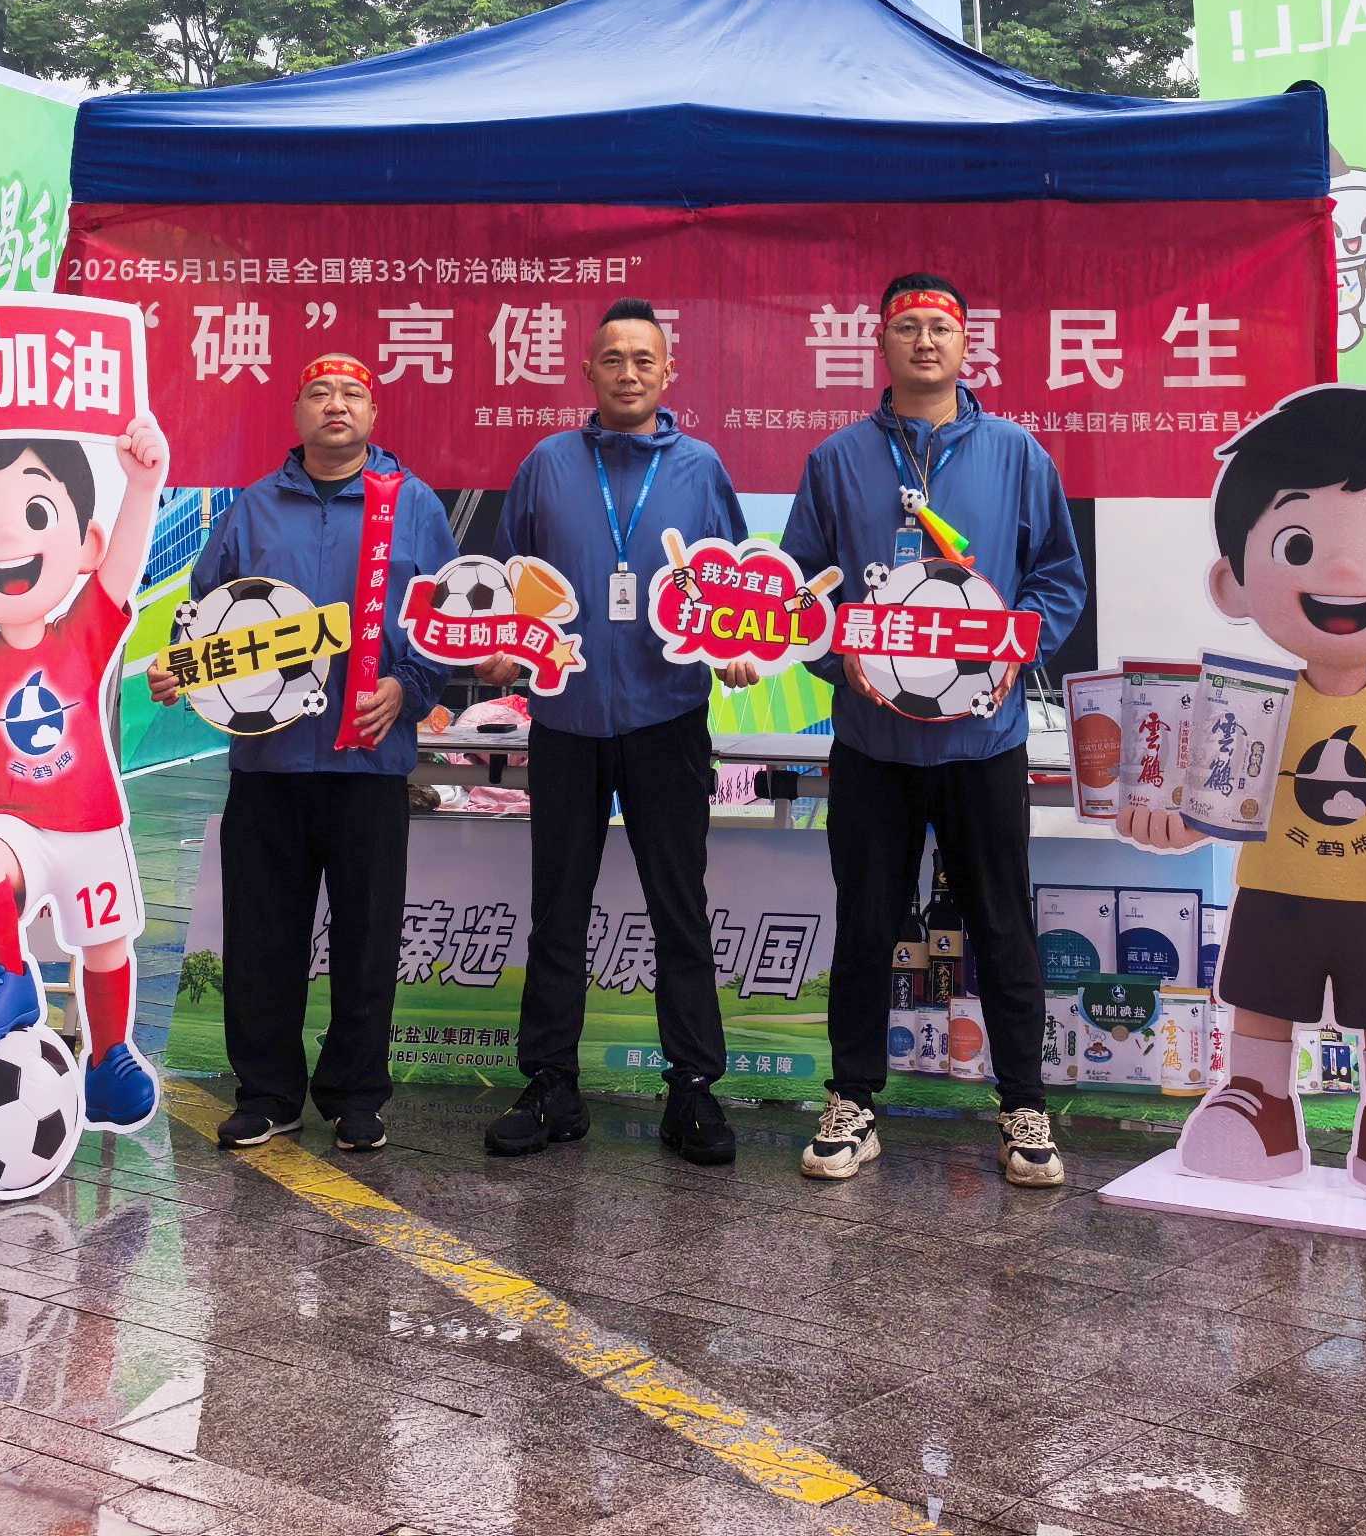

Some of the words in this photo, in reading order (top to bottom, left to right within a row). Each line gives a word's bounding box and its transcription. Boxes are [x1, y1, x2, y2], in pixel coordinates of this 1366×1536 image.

[139, 302, 681, 386] “碘”亮健
[984, 410, 1262, 433] 北盐业集团有限公司宜昌
[362, 542, 389, 640] 宜昌加油
[701, 562, 784, 598] 我为宜昌
[427, 621, 549, 651] E哥助威团
[677, 599, 811, 646] 打CALL
[842, 609, 1027, 659] 最佳十二人
[167, 613, 343, 690] 最佳十二人
[76, 881, 122, 930] 12
[389, 1025, 520, 1046] 北盐业集团有限
[726, 1054, 794, 1075] 全保障
